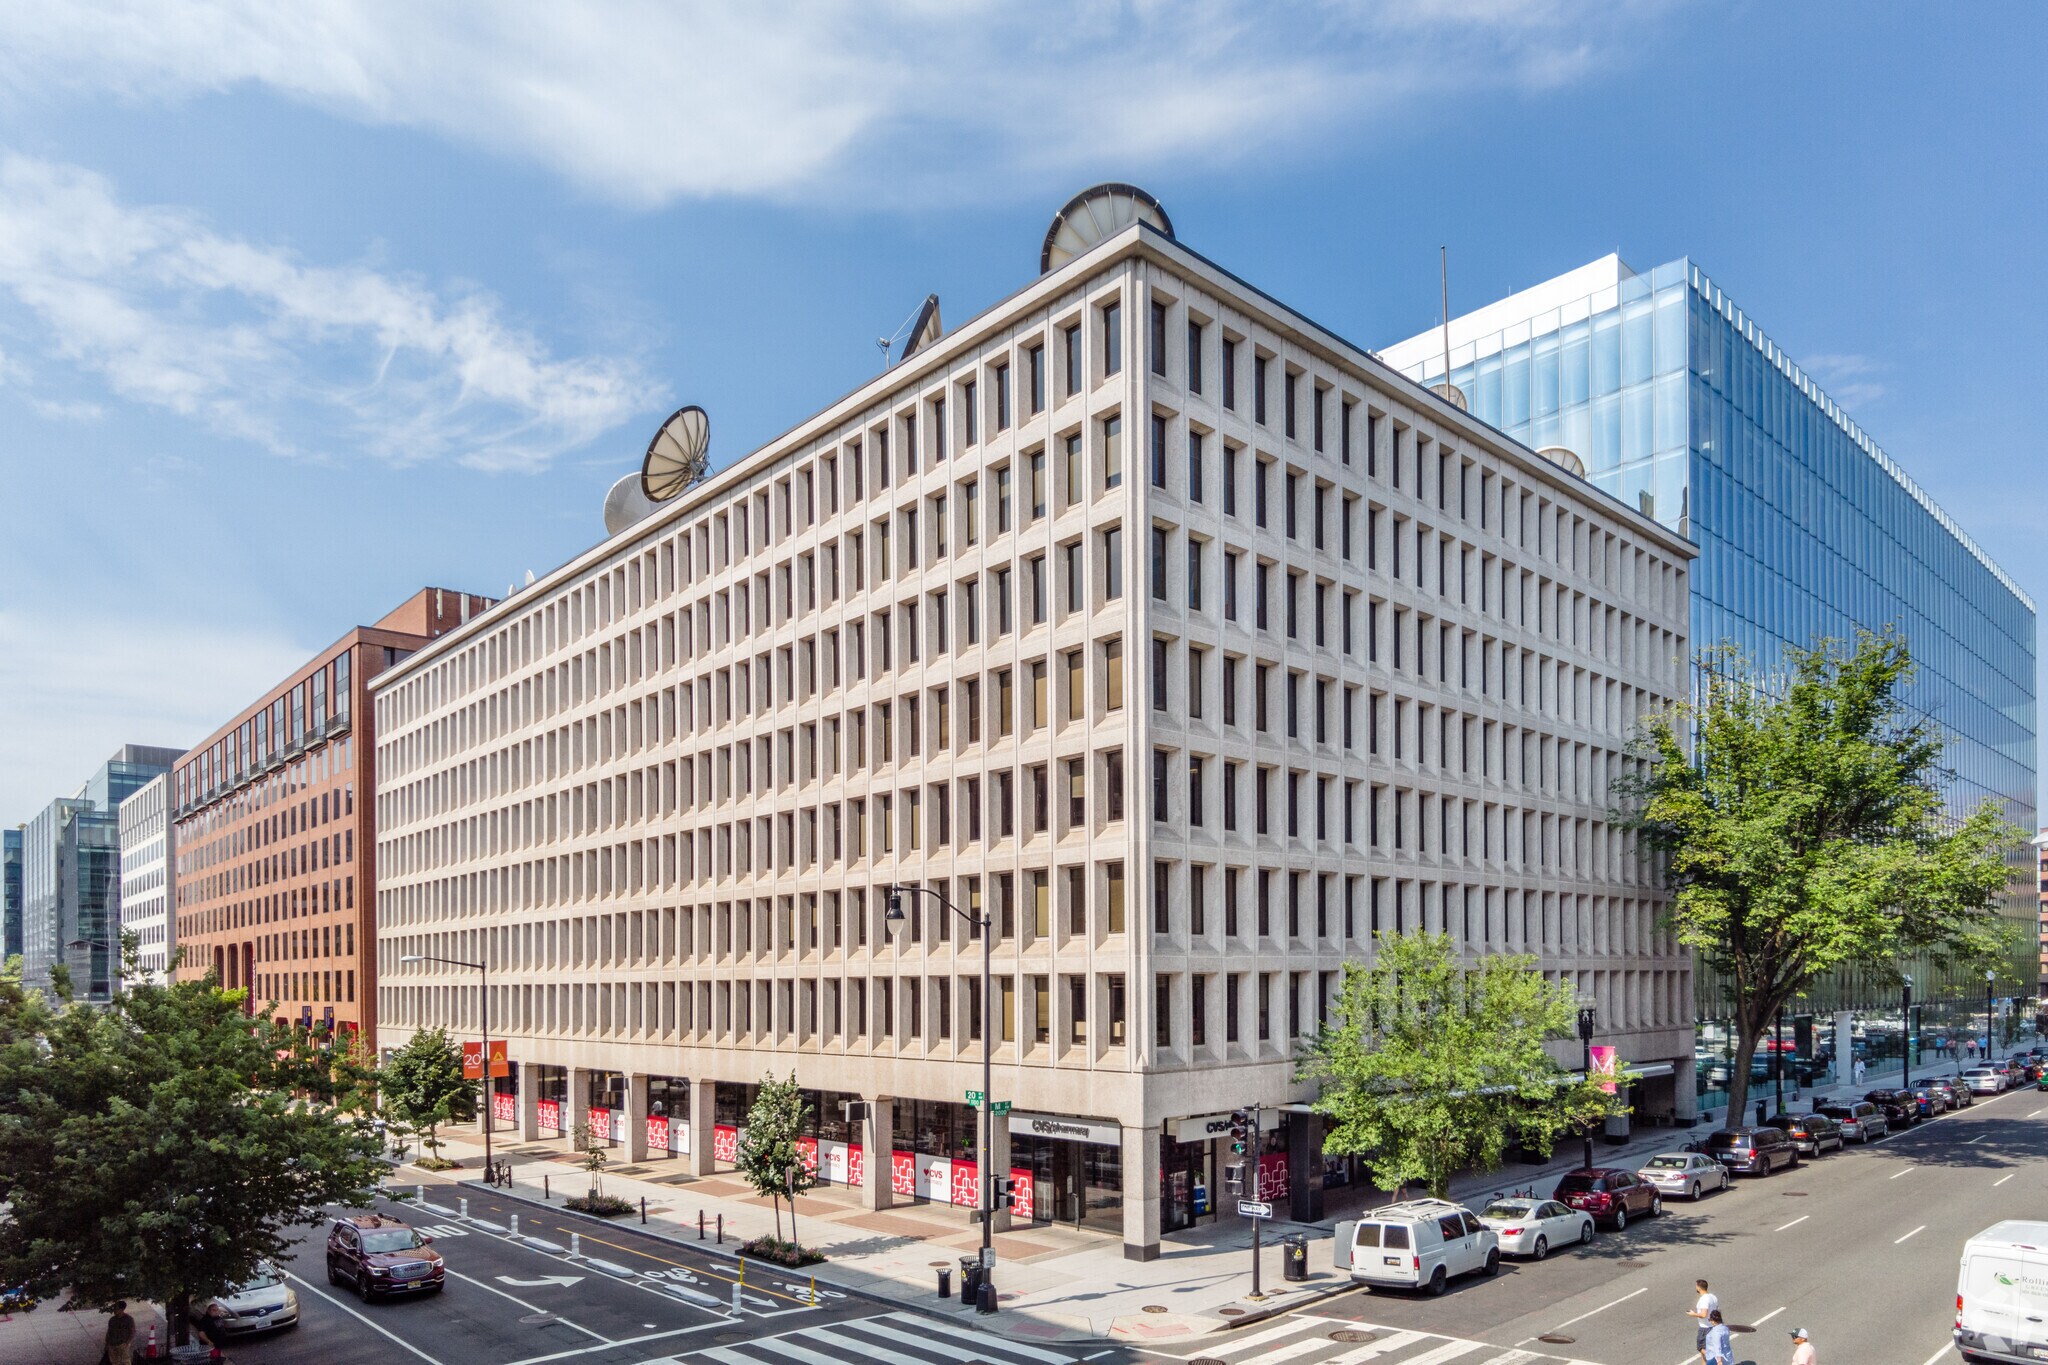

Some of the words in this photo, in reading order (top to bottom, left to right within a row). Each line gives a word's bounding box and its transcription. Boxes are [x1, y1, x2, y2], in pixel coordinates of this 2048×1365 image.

[464, 1053, 482, 1066] 20
[1592, 1054, 1614, 1076] M
[967, 1091, 976, 1100] 20
[994, 1102, 1001, 1110] M
[830, 1152, 841, 1162] CVS
[929, 1168, 943, 1179] CVS
